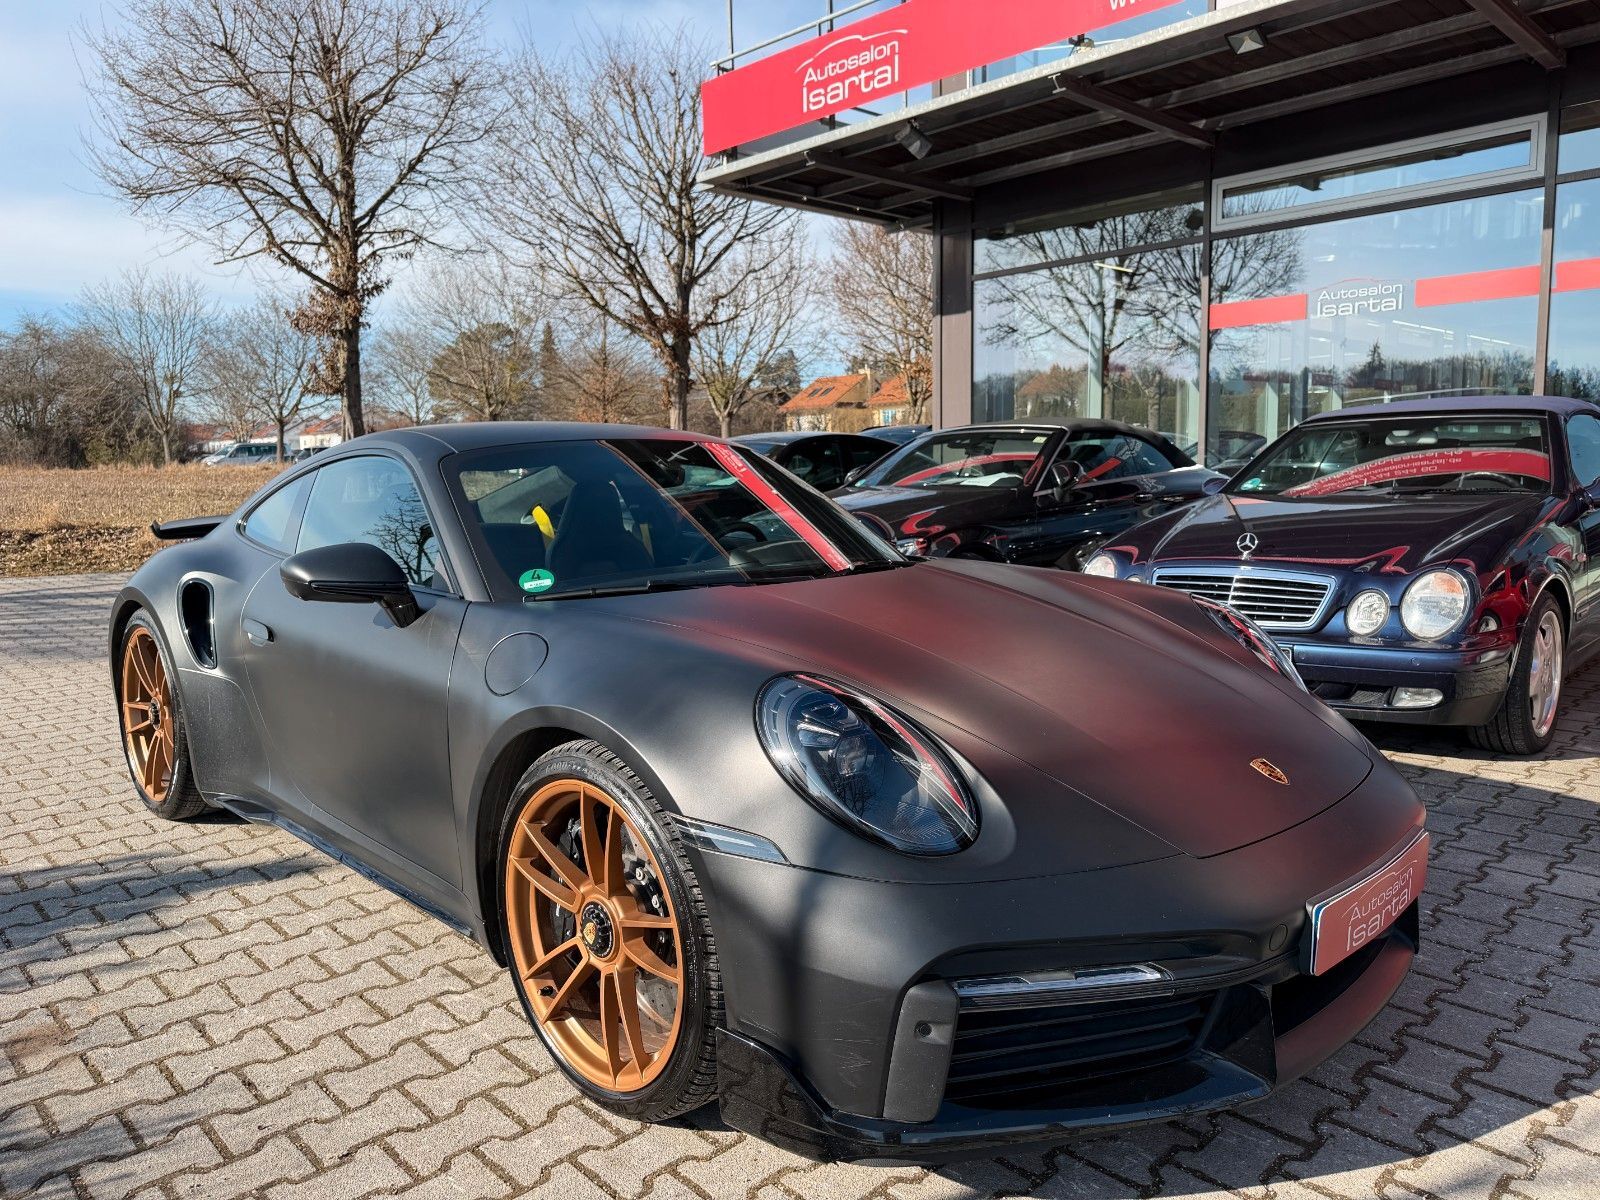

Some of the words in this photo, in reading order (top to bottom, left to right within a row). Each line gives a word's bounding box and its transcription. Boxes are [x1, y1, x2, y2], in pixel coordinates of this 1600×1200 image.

[802, 56, 899, 113] Isartal
[803, 42, 899, 85] Autosalon
[1318, 283, 1403, 301] Autosalon
[1319, 293, 1403, 318] Isartal
[532, 569, 541, 580] 4
[1346, 878, 1412, 951] Isartal
[1350, 867, 1413, 922] Autosalon
